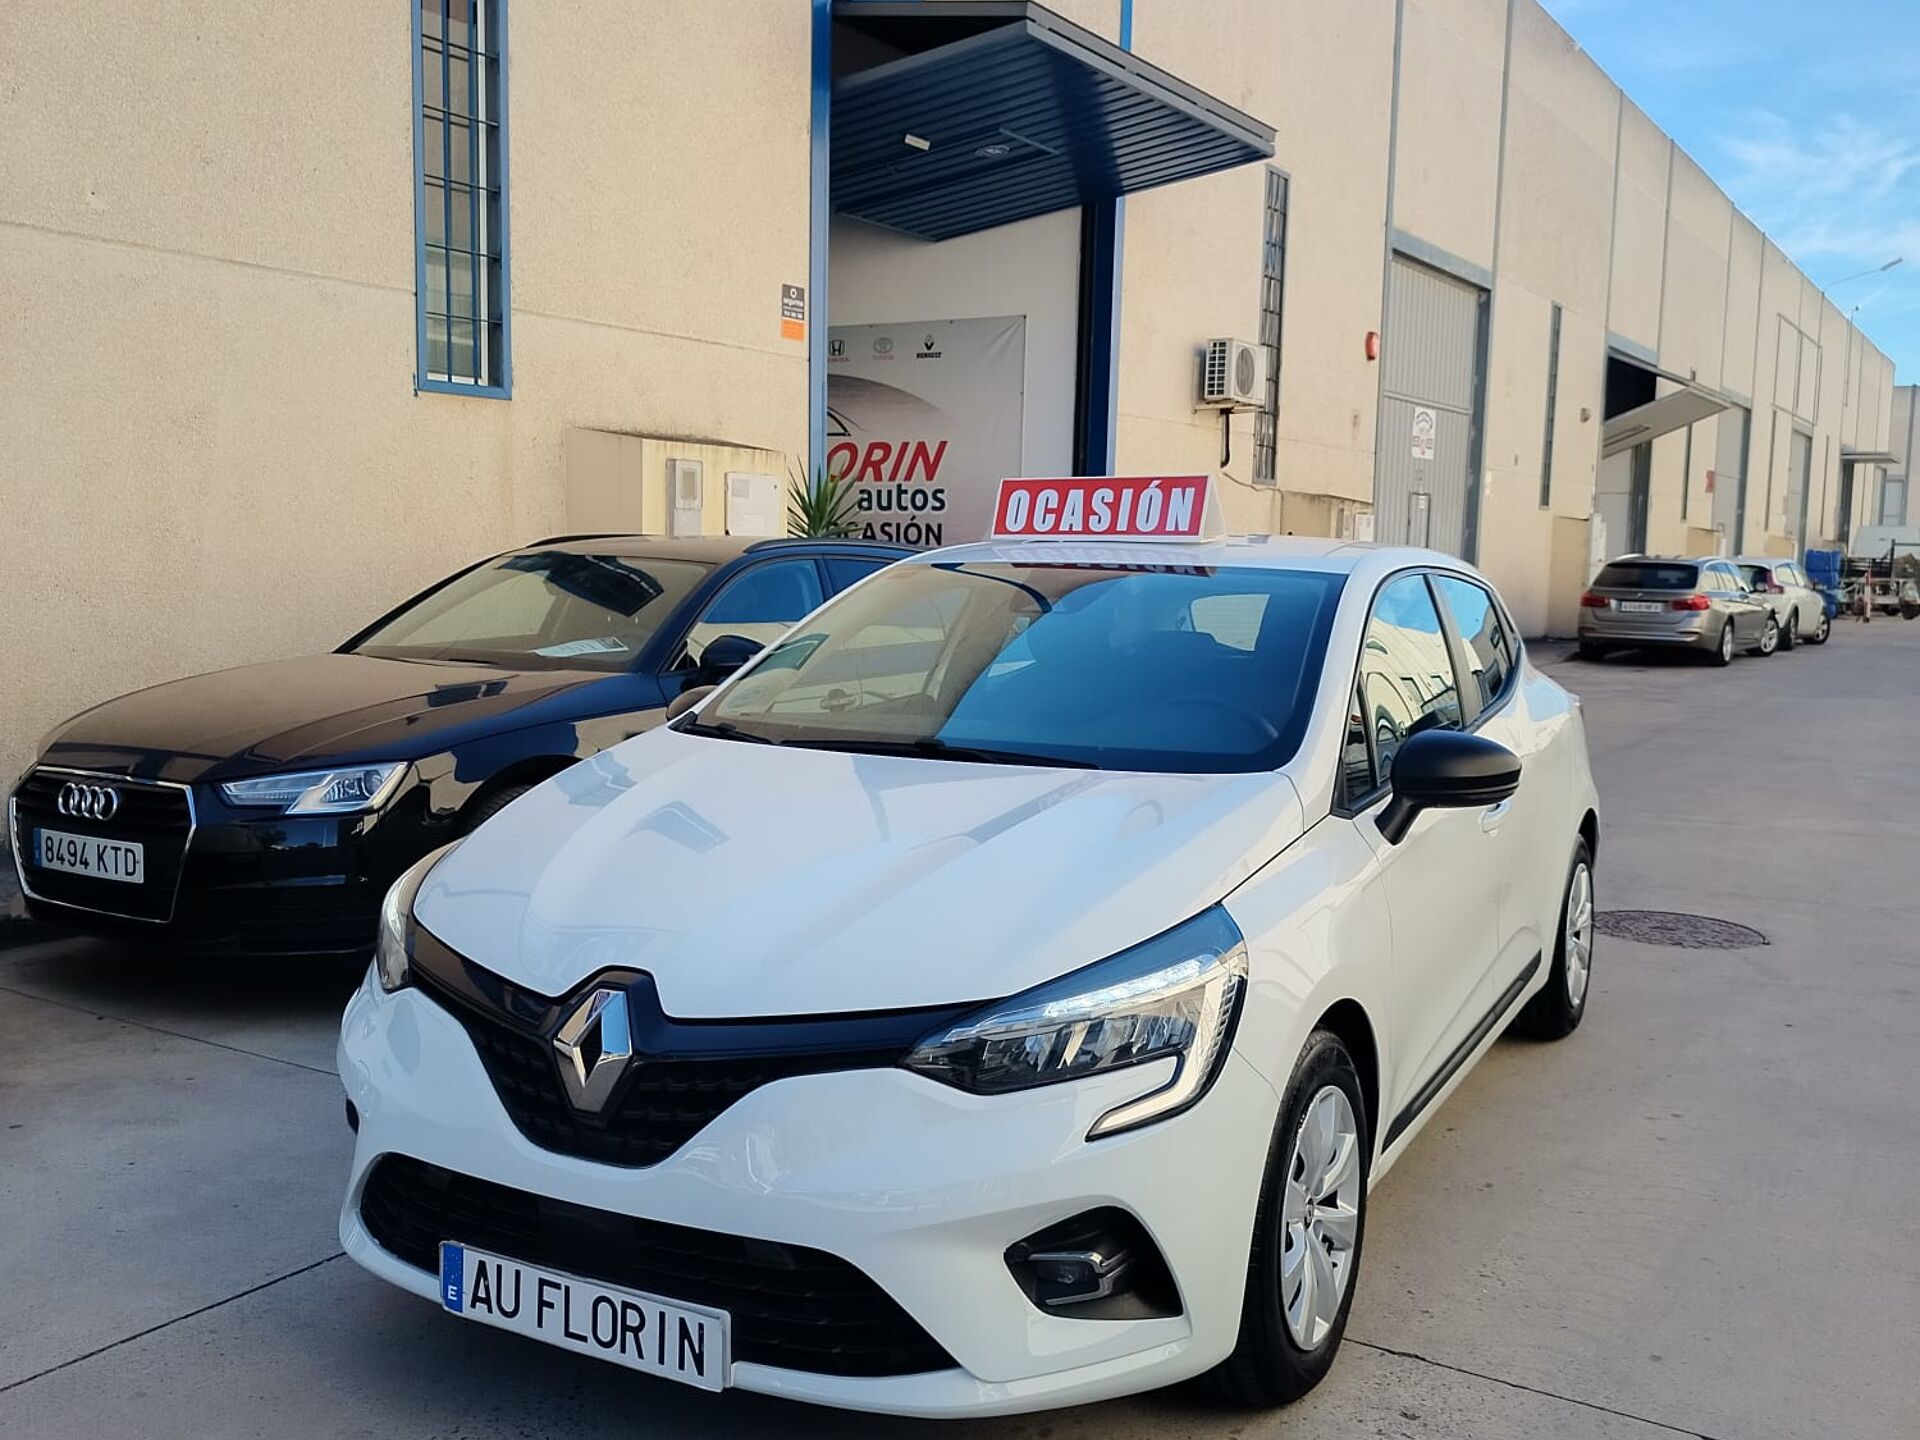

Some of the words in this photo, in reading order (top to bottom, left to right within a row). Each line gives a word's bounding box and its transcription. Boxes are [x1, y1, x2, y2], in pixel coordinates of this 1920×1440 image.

[857, 483, 946, 511] autos
[1005, 480, 1195, 533] OCASIÓN
[832, 515, 942, 546] ASIÓN
[45, 836, 89, 870] 8494
[97, 844, 136, 876] KTD
[470, 1260, 521, 1319] AU
[537, 1277, 705, 1377] FLORIN
